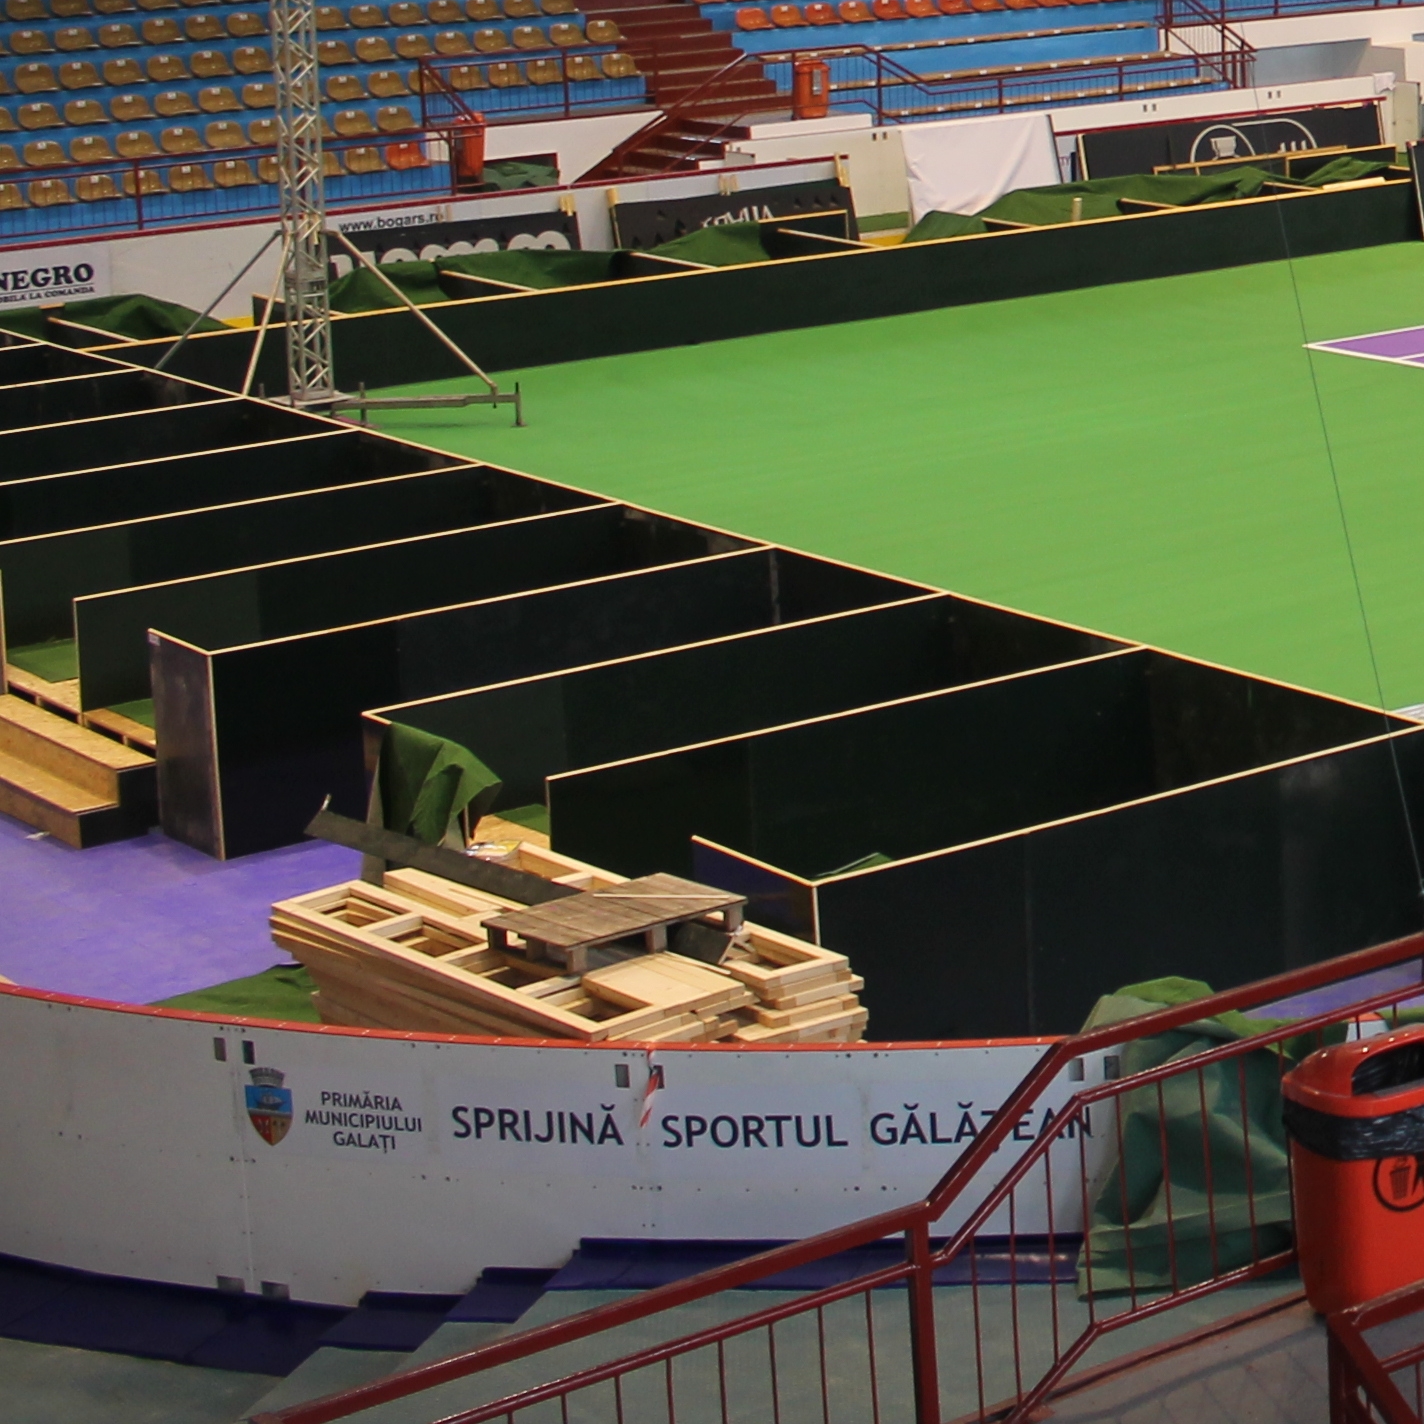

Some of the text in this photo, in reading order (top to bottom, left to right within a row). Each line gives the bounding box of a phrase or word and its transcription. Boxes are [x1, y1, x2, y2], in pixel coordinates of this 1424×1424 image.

[29, 292, 43, 300] LA
[44, 286, 95, 298] COMANDA
[321, 1090, 402, 1111] PRIMĂRIA
[305, 1110, 422, 1132] MUNICIPIULUI
[451, 1103, 624, 1146] SPRIJINĂ
[661, 1115, 849, 1148] SPORTUL
[333, 1131, 396, 1153] GALAȚI
